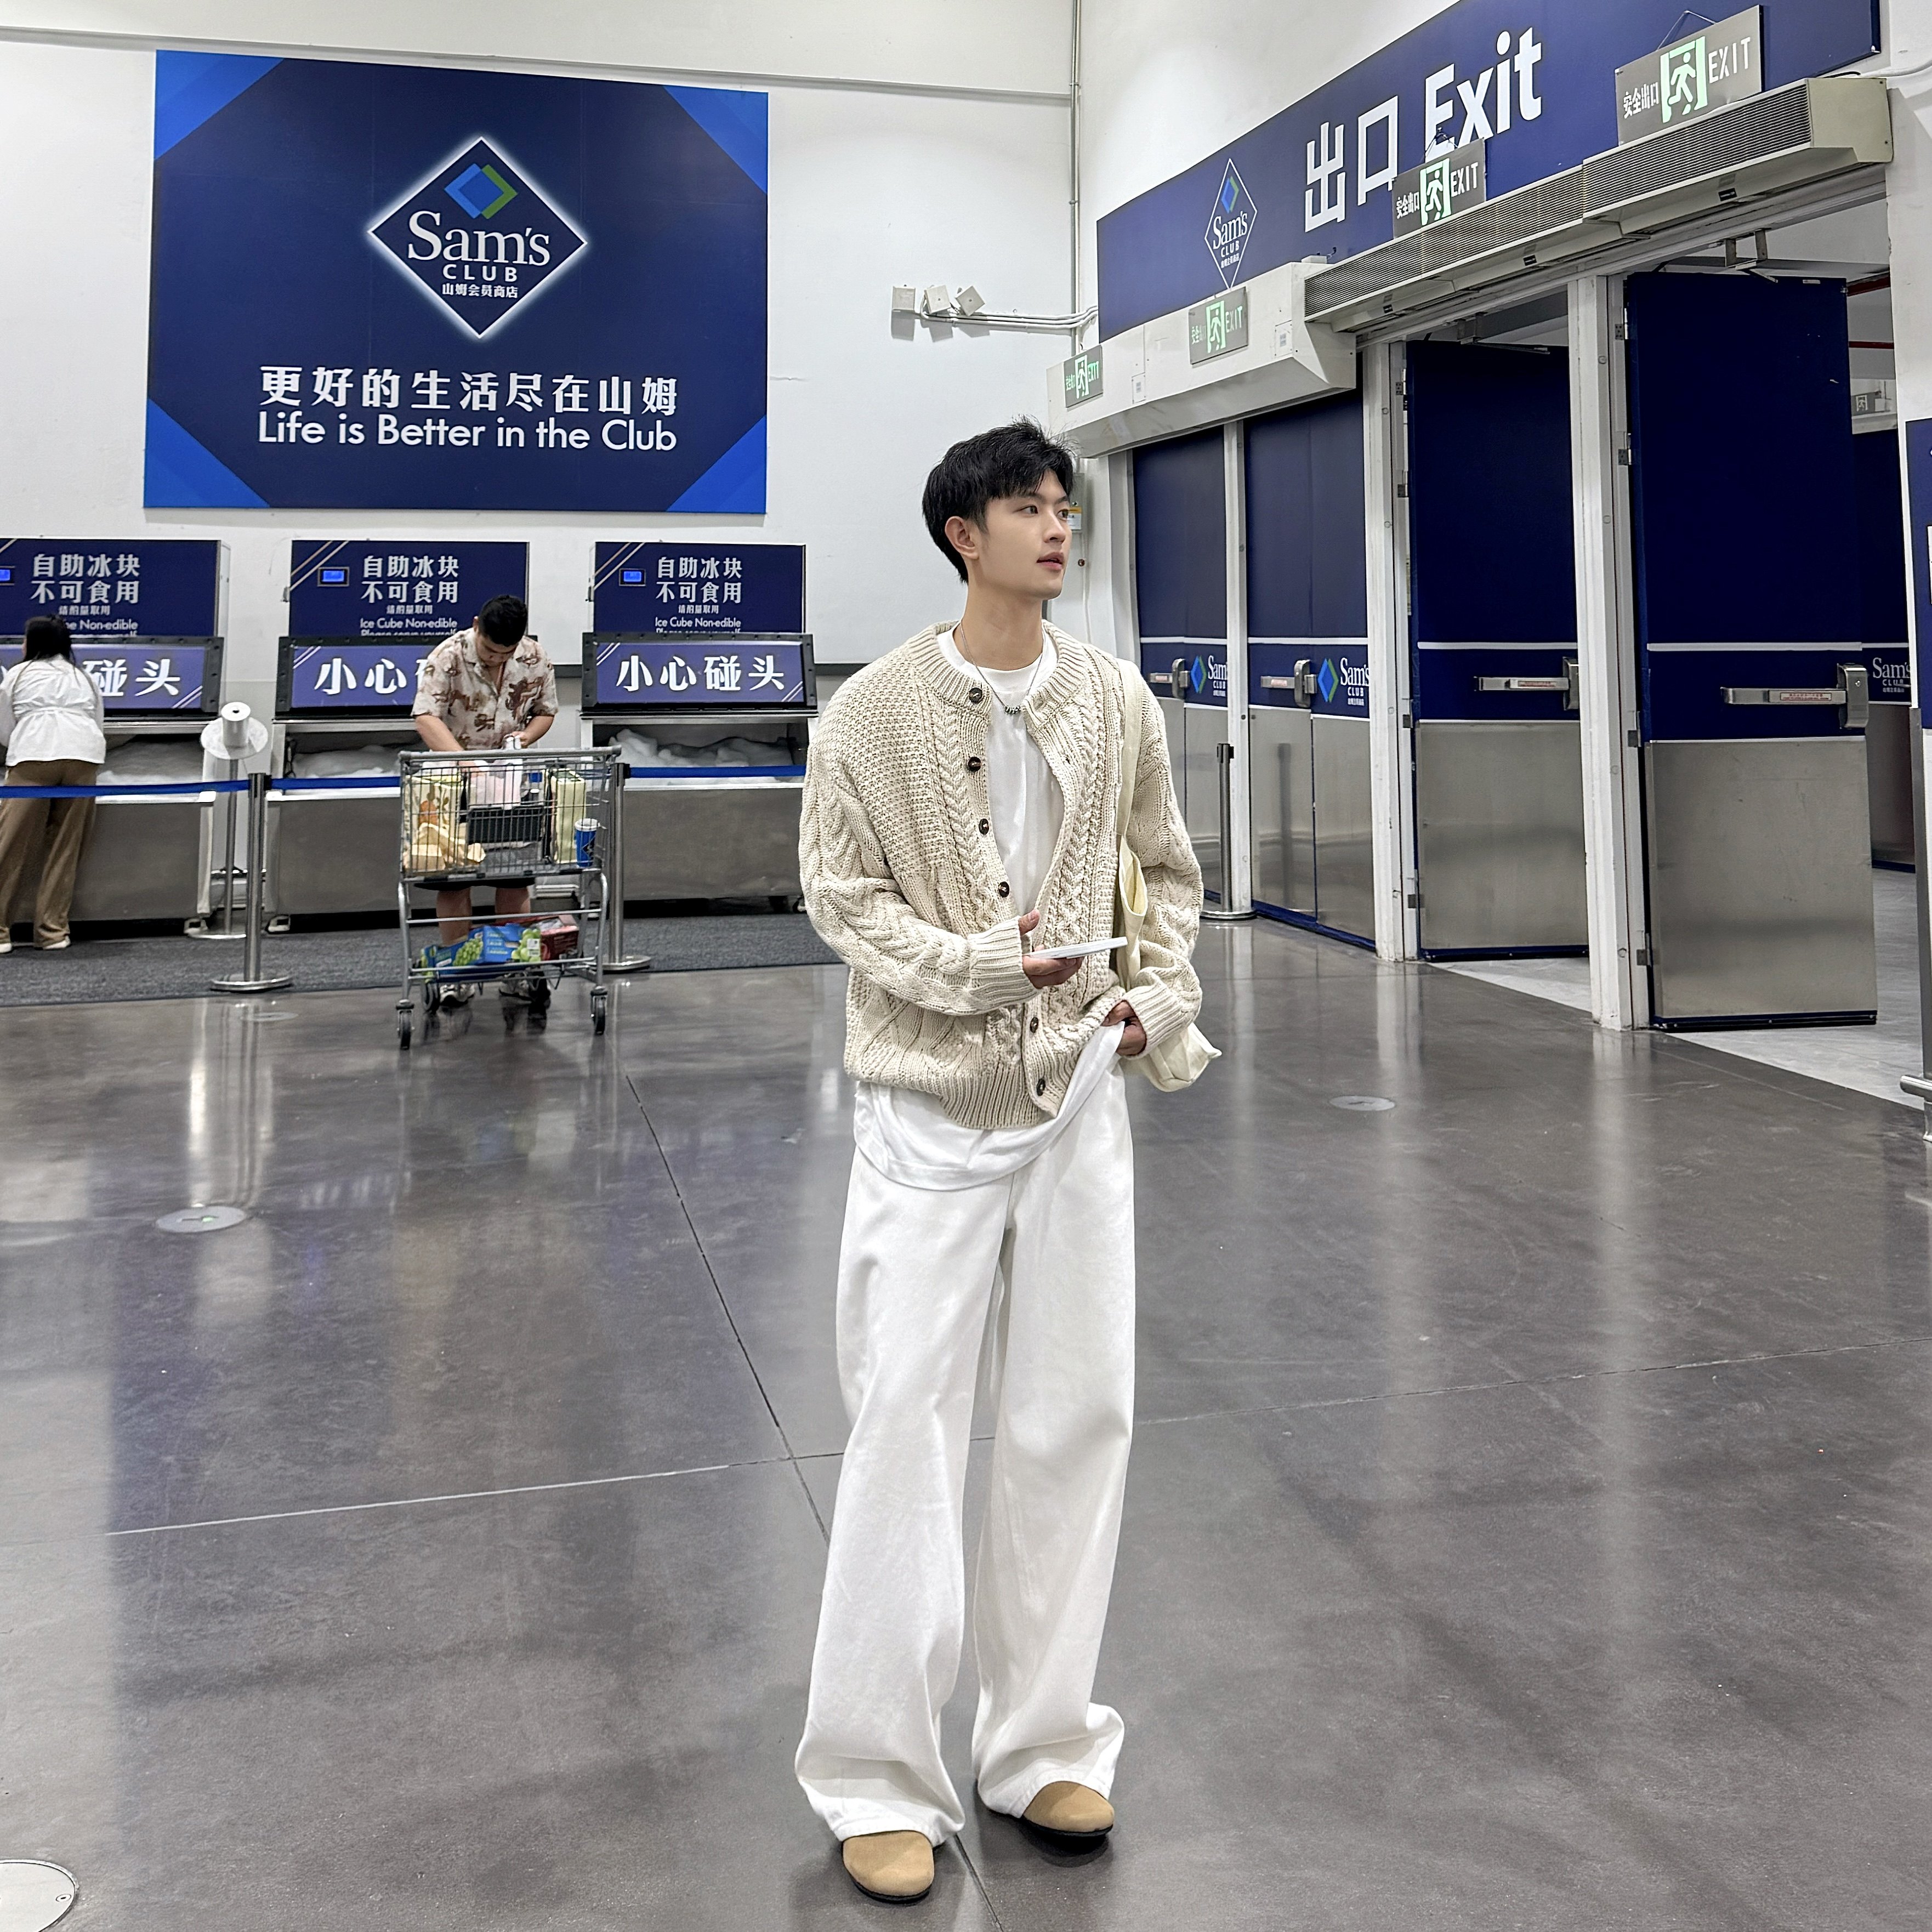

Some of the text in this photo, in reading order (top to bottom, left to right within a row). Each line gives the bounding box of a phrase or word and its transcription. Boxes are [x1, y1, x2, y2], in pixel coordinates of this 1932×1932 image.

[1623, 37, 1751, 119] 安全出口 EXIT
[1305, 27, 1542, 232] 出口 Exit
[1396, 162, 1479, 219] 安全出口 EXIT
[408, 211, 550, 266] Sam's
[1213, 211, 1248, 249] Sam's
[1220, 240, 1239, 258] CLUB
[442, 264, 518, 282] CLUB
[442, 283, 518, 298] 山姆会员商店
[1225, 306, 1243, 333] EXIT
[260, 366, 677, 416] 更好的生活尽在山姆
[259, 411, 677, 451] Life is Better in the Club
[32, 553, 140, 577] 自助冰块
[363, 555, 459, 578] 自助冰块
[658, 556, 742, 579] 自助冰块
[30, 579, 140, 604] 不可食用
[360, 581, 458, 603] 不可食用
[655, 581, 742, 604] 不可食用
[79, 618, 138, 630] Non-edible
[360, 617, 458, 629] Ice Cube Non-edible
[655, 616, 741, 628] Ice Cube Non-edible
[314, 657, 430, 695] 小心
[615, 655, 785, 692] 小心碰头
[1340, 657, 1370, 686] Sam's
[1348, 686, 1364, 697] CLUB
